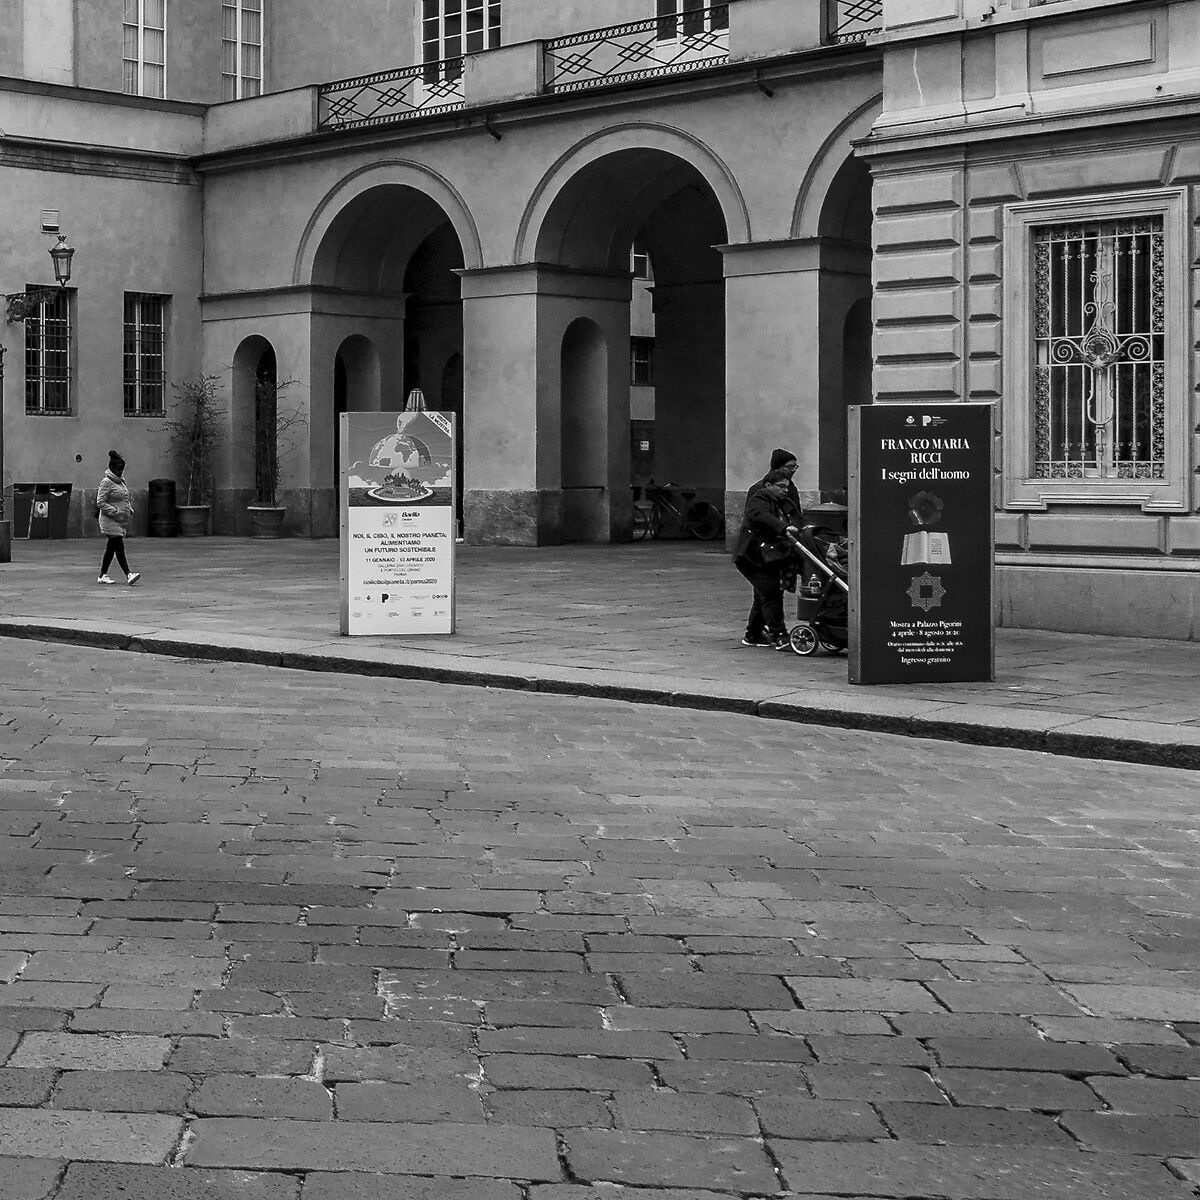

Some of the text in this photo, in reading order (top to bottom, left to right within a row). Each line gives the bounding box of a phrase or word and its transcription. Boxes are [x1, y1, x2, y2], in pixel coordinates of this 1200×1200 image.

[881, 438, 970, 450] FRANCO MARIA
[910, 452, 942, 464] RICCI
[881, 467, 970, 484] I segni dell'uomo
[890, 620, 911, 628] Mostra
[916, 620, 938, 628] Palazzo
[898, 629, 915, 638] aprile
[924, 630, 944, 638] agosto
[901, 656, 951, 665] Ingresso gratuito
